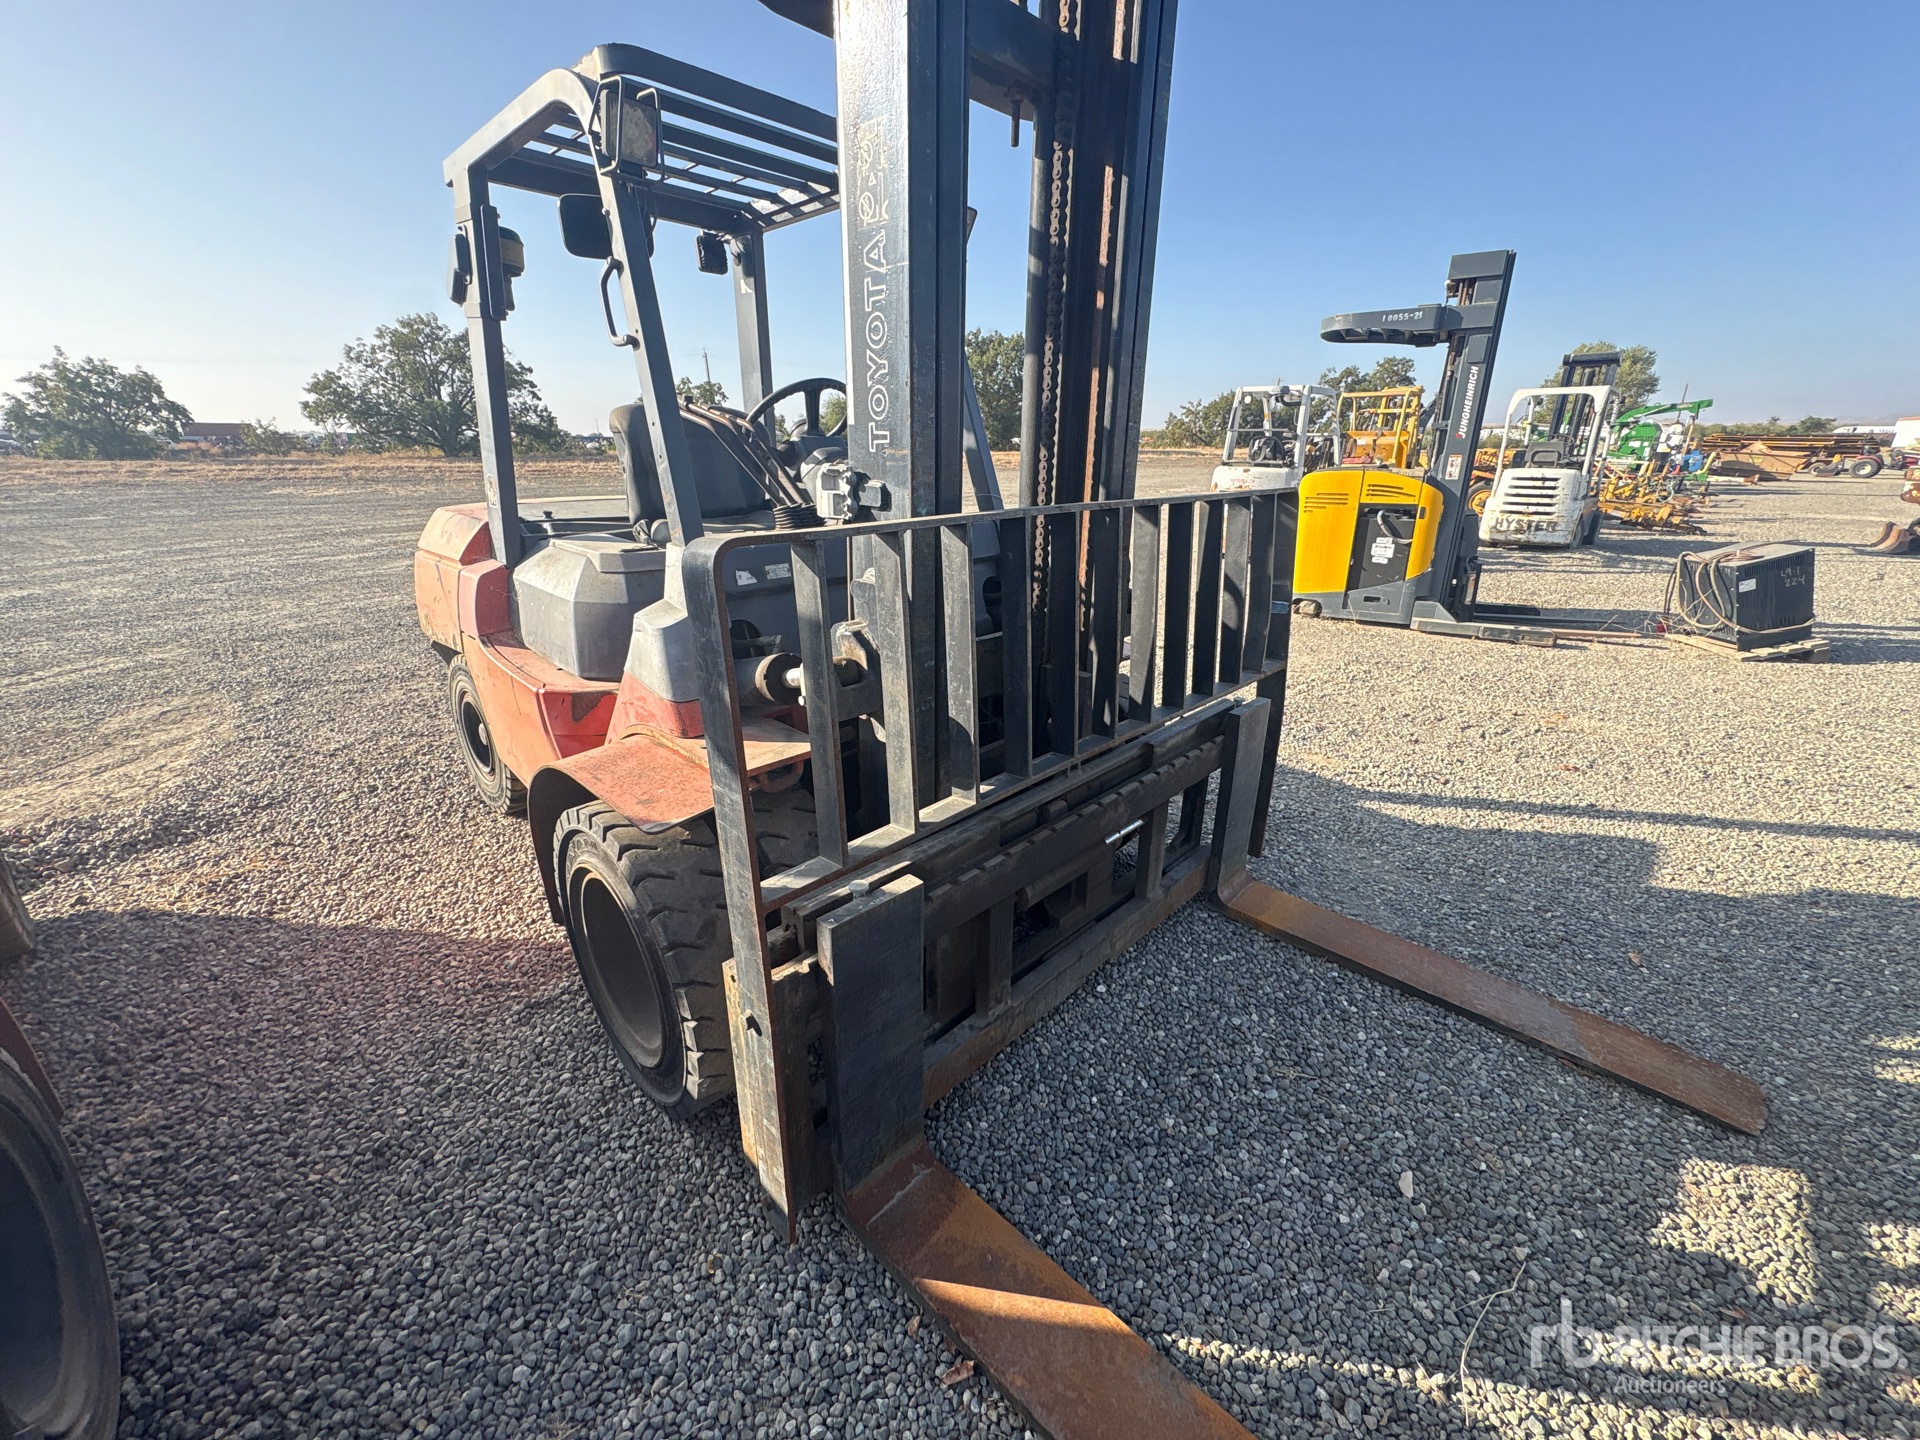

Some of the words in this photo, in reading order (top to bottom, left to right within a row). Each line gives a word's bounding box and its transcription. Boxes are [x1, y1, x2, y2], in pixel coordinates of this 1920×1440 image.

[864, 229, 890, 452] TOYOTA
[1456, 365, 1479, 439] JUNGHEINRICH
[1494, 515, 1558, 534] HYSTER
